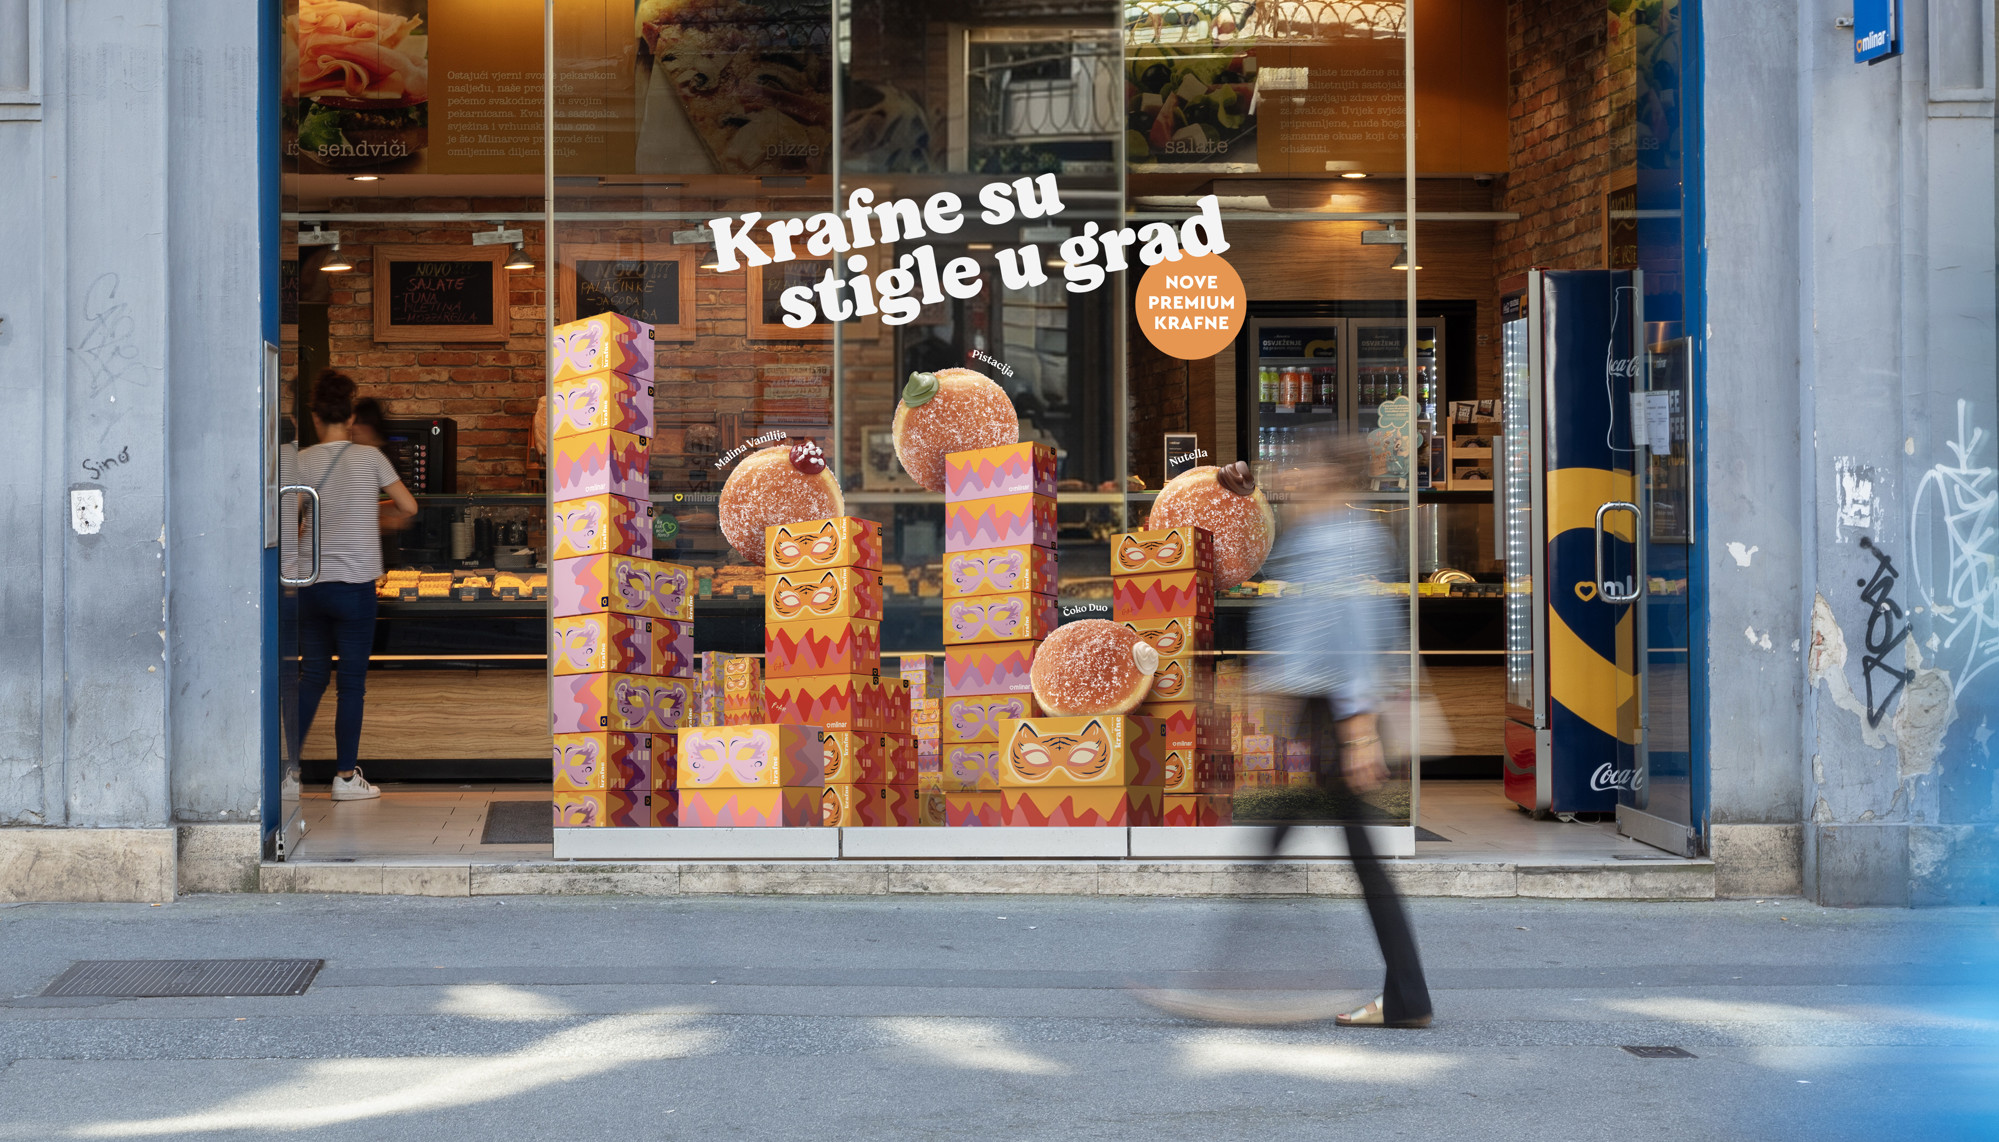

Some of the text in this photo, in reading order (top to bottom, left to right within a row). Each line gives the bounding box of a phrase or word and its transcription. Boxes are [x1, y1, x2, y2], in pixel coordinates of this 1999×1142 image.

[1862, 30, 1886, 52] mlinar
[492, 71, 522, 81] vjerni
[560, 71, 616, 82] pekarskom
[498, 84, 520, 92] naše
[568, 97, 602, 107] svojim
[1381, 94, 1405, 102] obro
[478, 134, 530, 144] Mlinarove
[318, 140, 408, 156] sendviči
[764, 140, 820, 160] pizze
[1164, 139, 1229, 154] salate
[709, 172, 1065, 271] Krafne su
[779, 194, 1230, 329] stigle u grad
[1166, 276, 1218, 289] NOVE
[1148, 297, 1234, 309] PREMIUM
[1154, 315, 1228, 330] KRAFNE
[972, 349, 1014, 378] Pistacija
[714, 444, 747, 470] Malina
[747, 430, 786, 448] Vanilija
[1169, 448, 1208, 467] Nutella
[684, 492, 717, 502] mlinar
[1266, 491, 1290, 500] linar
[1062, 604, 1087, 617] Čoko
[1088, 604, 1108, 612] Duo
[830, 720, 848, 729] mlinar
